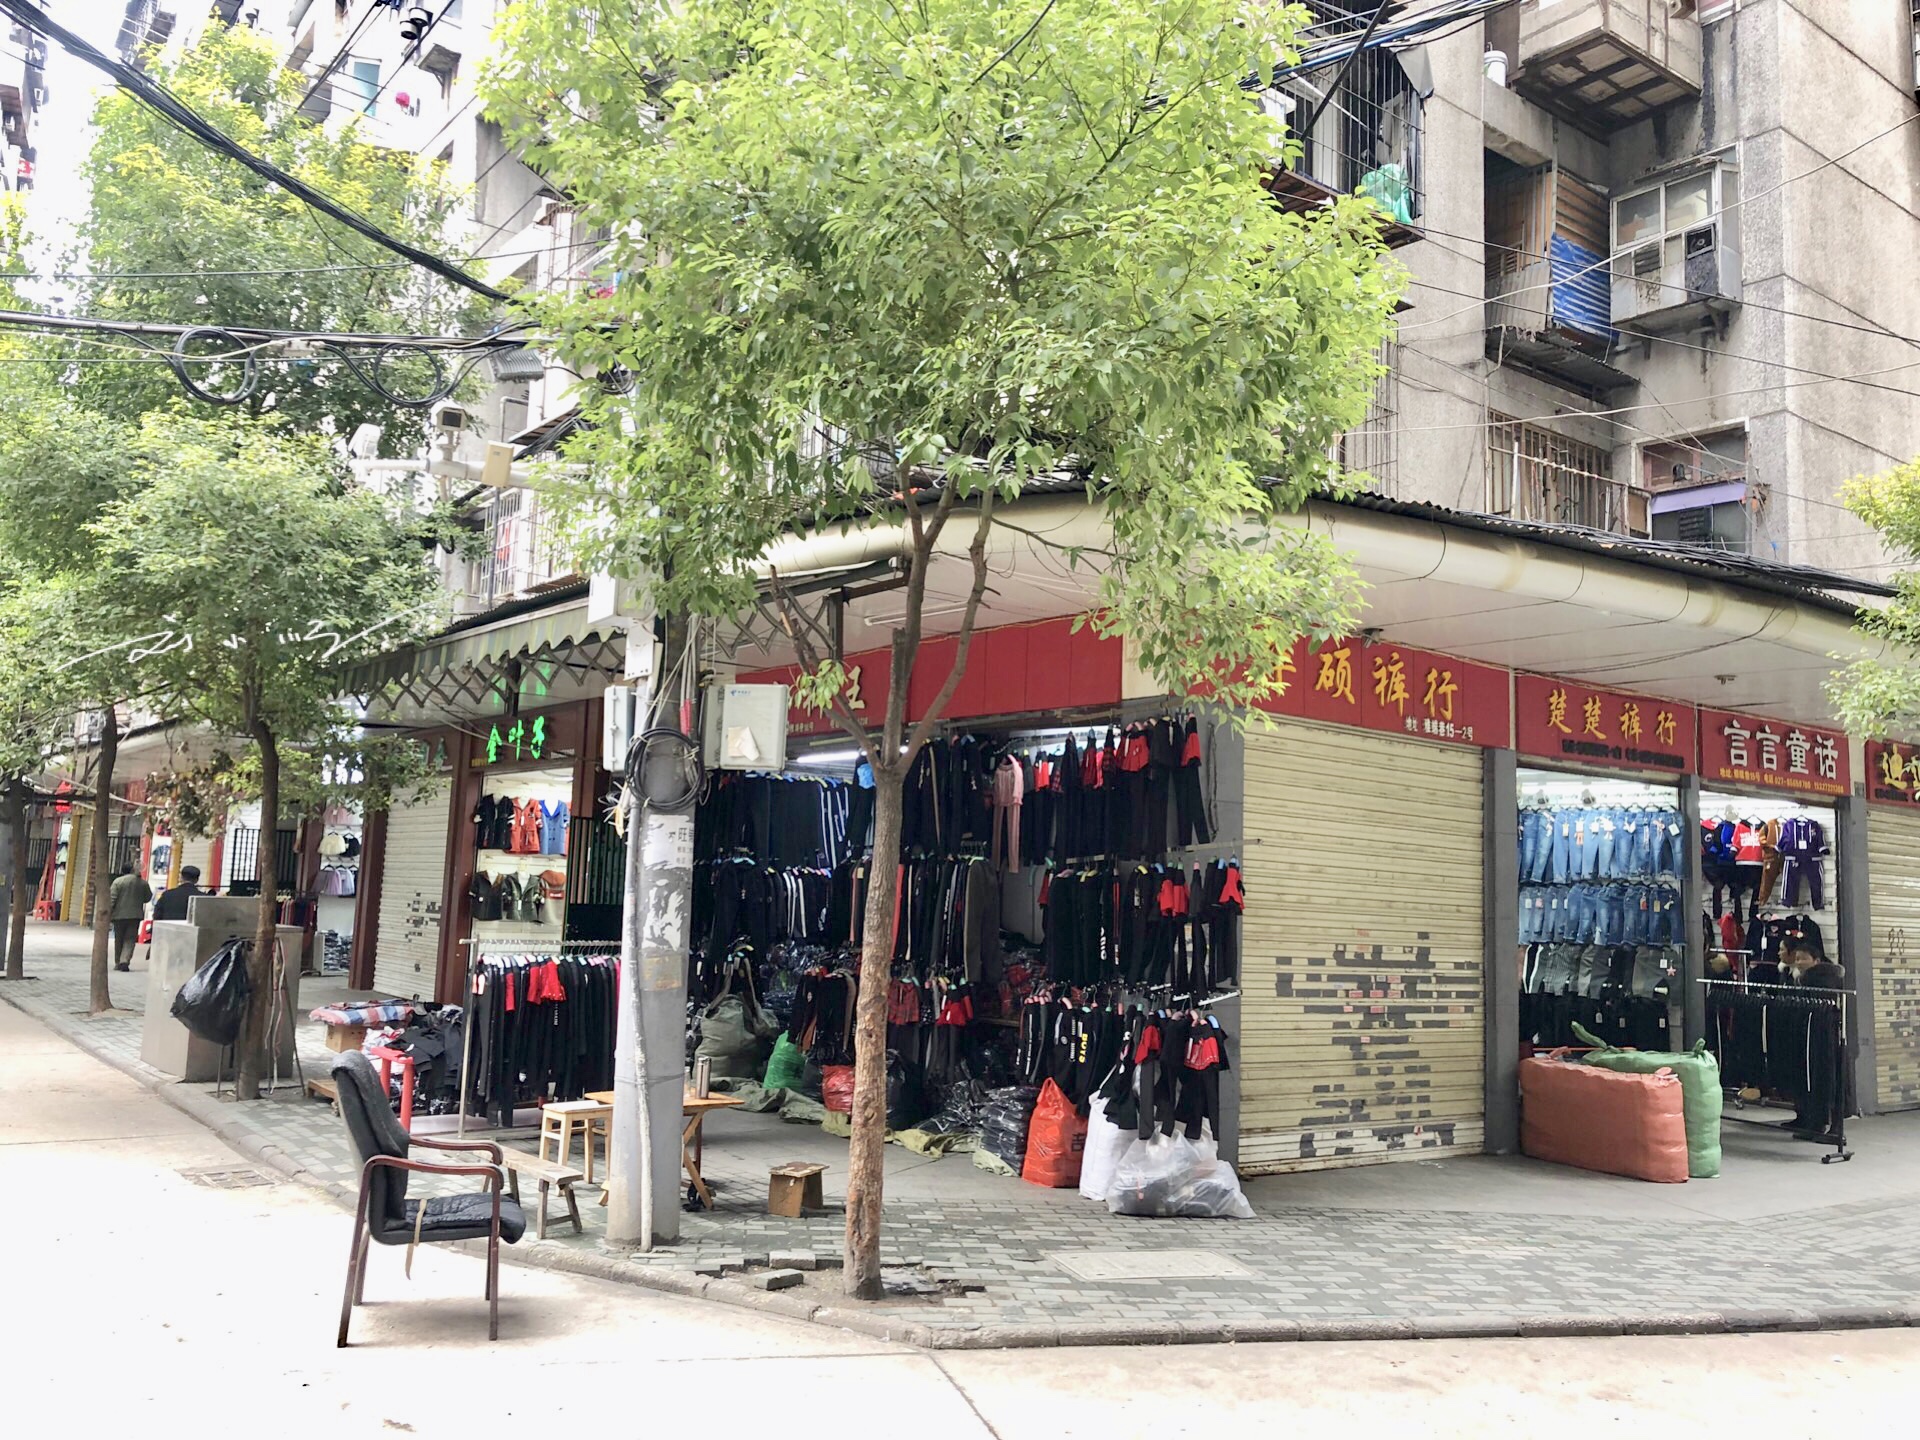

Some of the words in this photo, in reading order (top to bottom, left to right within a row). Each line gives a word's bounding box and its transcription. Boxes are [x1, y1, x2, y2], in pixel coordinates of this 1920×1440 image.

[1272, 646, 1458, 720] 硕裤行
[1547, 687, 1677, 746] 楚楚裤行
[1723, 719, 1839, 780] 言言童话
